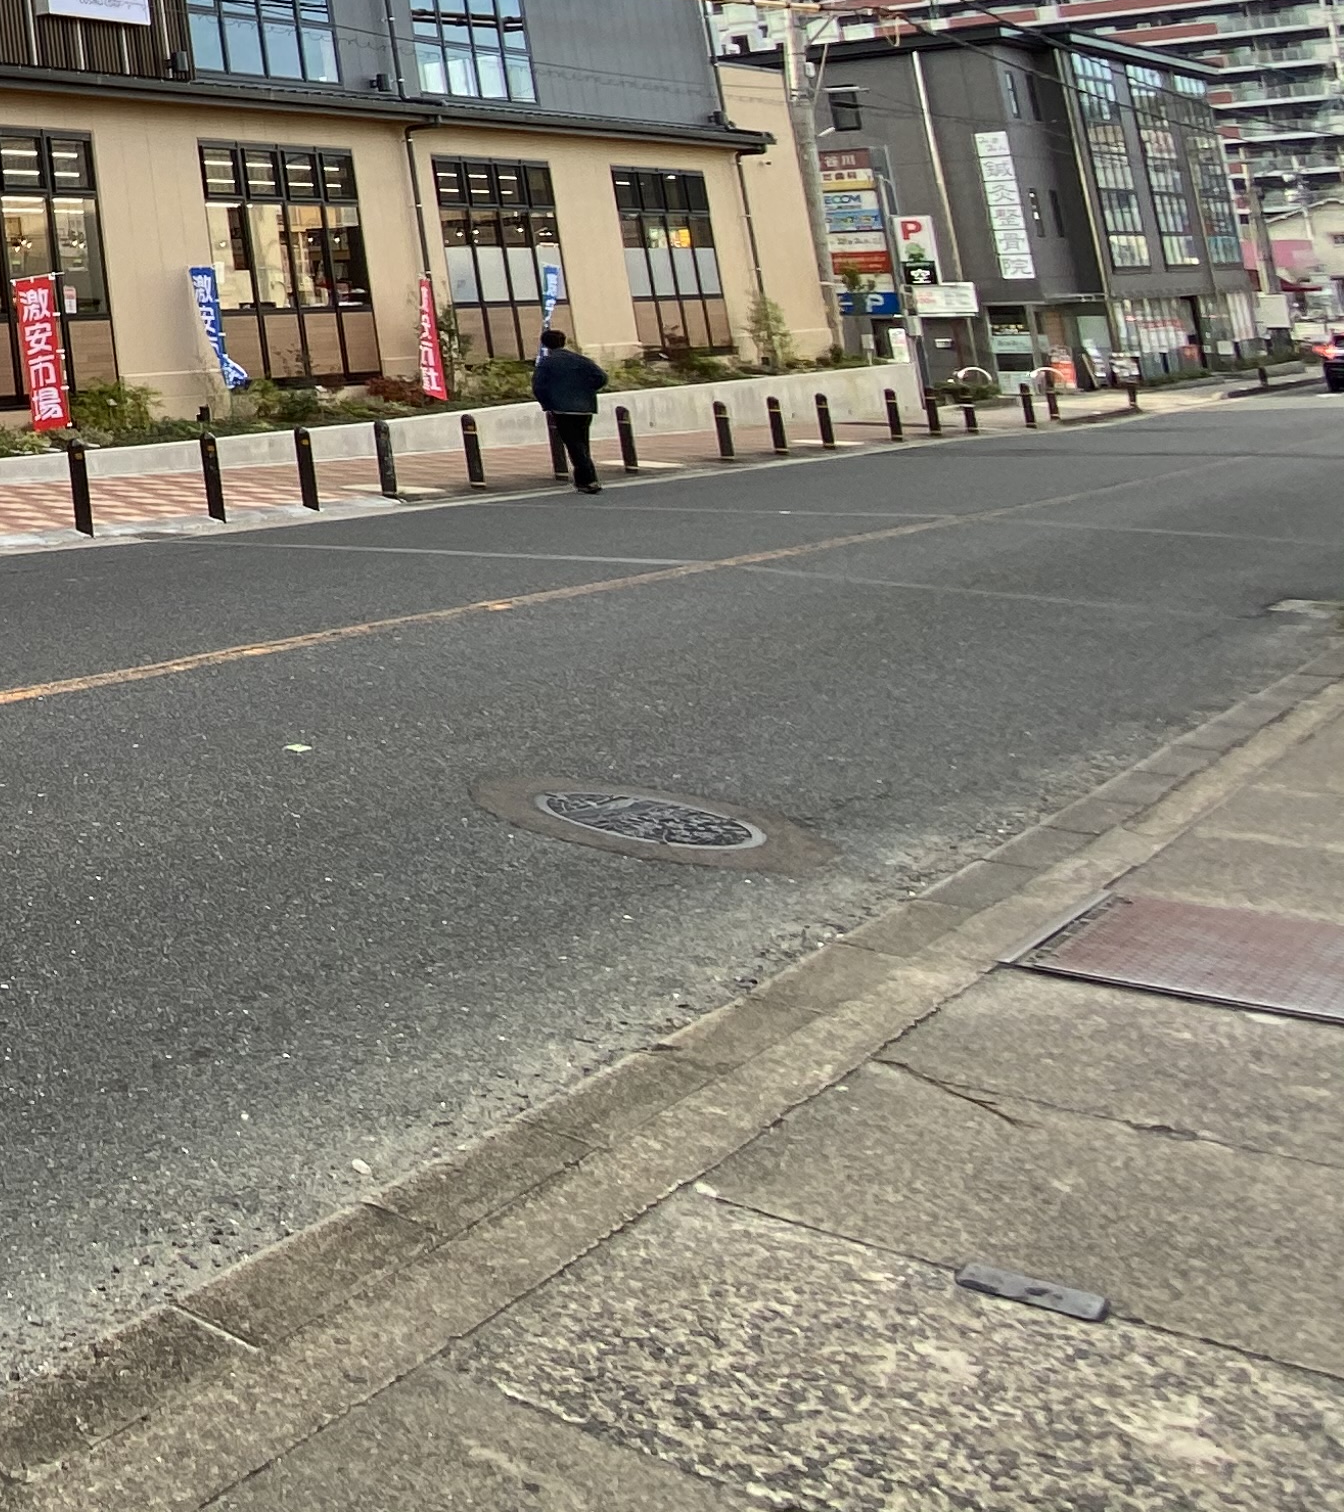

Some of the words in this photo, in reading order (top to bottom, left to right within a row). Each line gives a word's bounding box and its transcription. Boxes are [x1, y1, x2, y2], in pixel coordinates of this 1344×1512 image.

[900, 220, 922, 240] P
[865, 293, 885, 313] P
[18, 287, 64, 422] 激安市場
